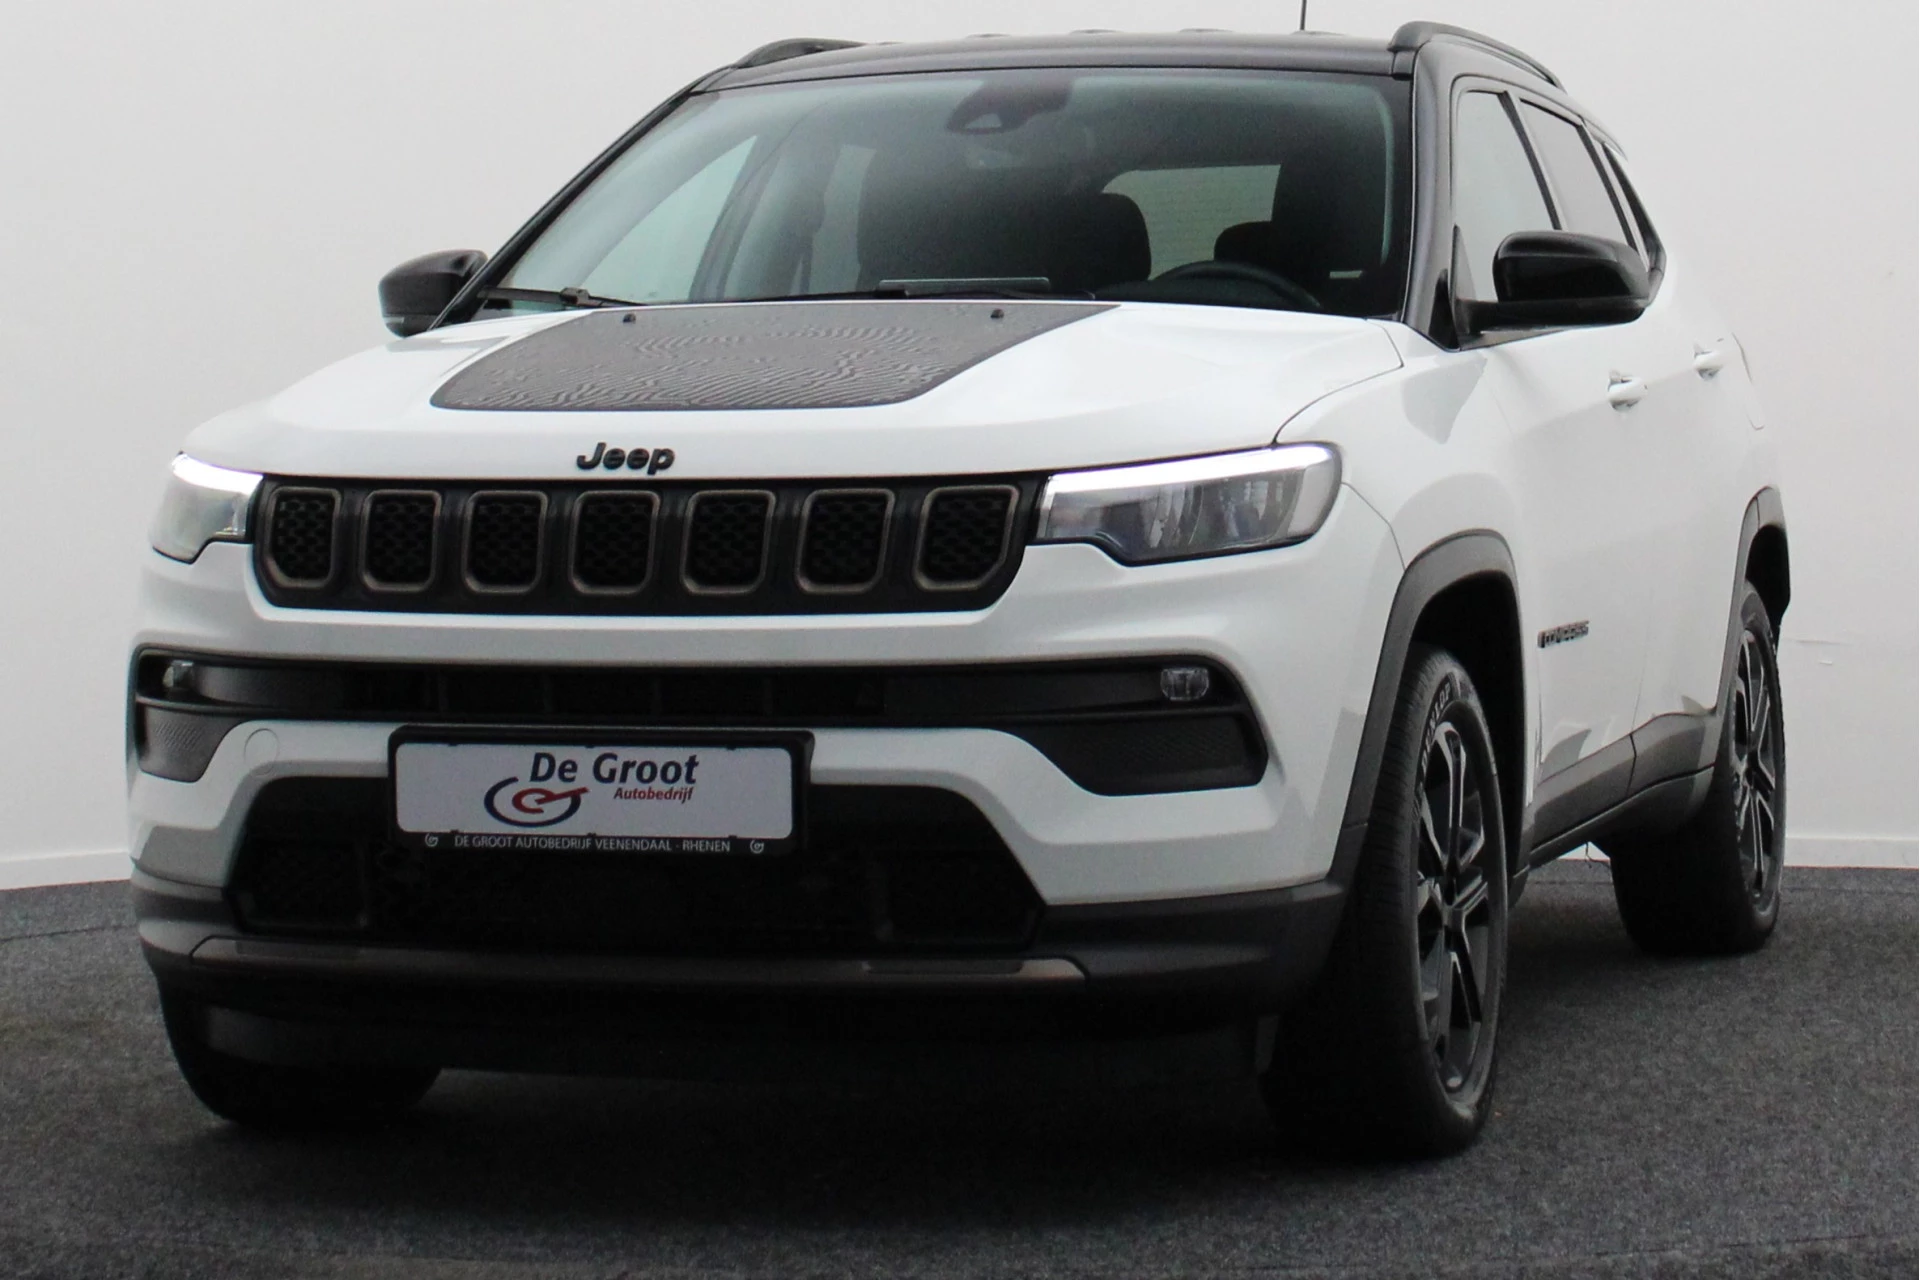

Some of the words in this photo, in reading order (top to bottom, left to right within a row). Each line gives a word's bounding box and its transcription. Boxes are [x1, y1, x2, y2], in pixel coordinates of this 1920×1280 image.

[576, 442, 675, 475] Jeep
[529, 752, 578, 783] De
[592, 752, 699, 784] Groot
[613, 786, 694, 804] Autobedrijf
[454, 835, 469, 847] DE
[472, 836, 513, 848] GROOT
[515, 837, 592, 849] AUTOBEDRIJF
[595, 838, 672, 851] VEENENDAAL
[682, 839, 730, 852] RHENEN
